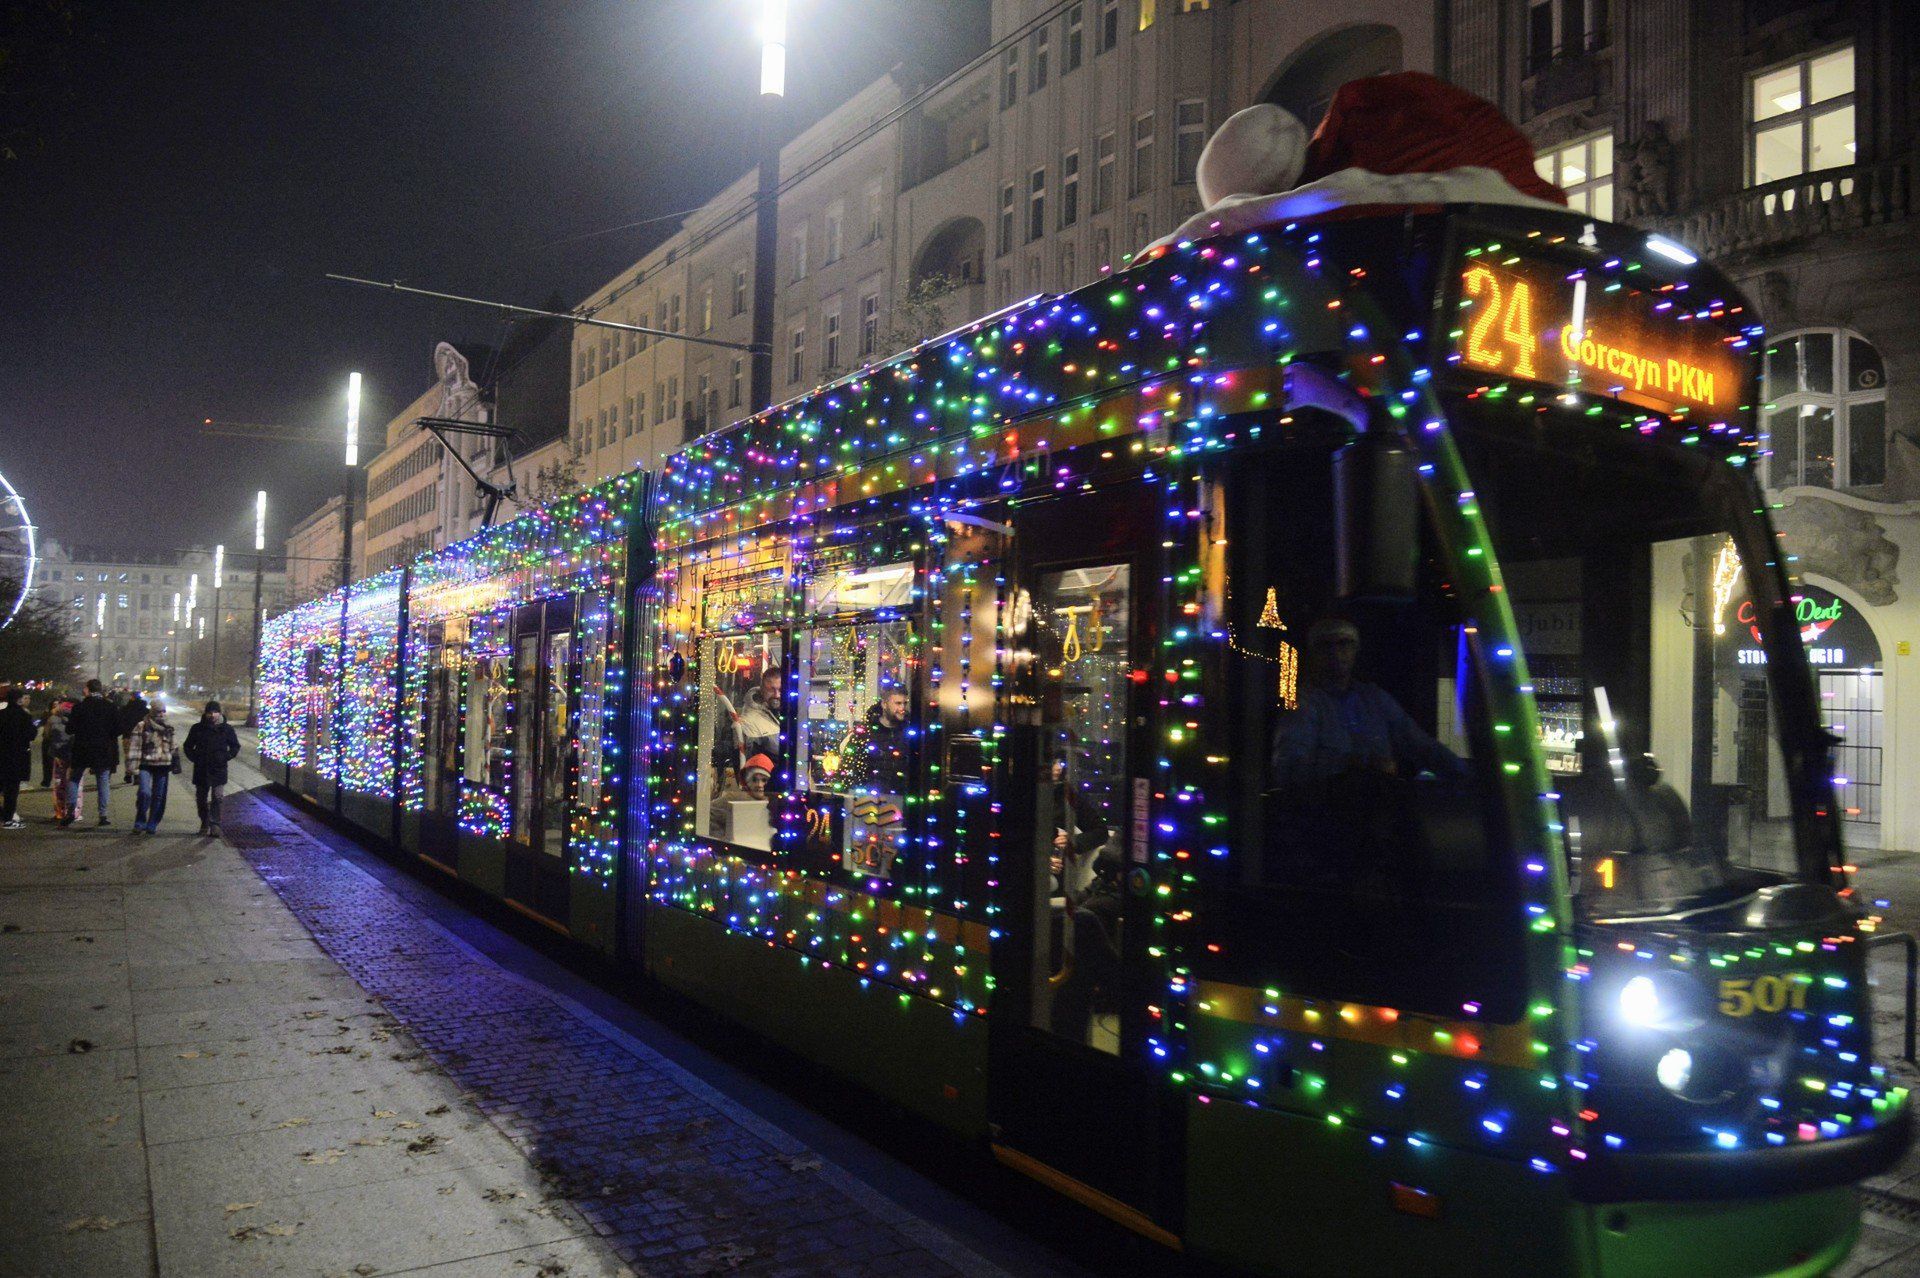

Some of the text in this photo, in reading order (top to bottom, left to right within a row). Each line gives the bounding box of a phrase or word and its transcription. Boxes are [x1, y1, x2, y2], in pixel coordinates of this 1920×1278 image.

[1465, 266, 1536, 379] 24
[1560, 323, 1714, 405] Górczyn PKM
[1596, 858, 1615, 888] 1
[1717, 974, 1807, 1018] 507
